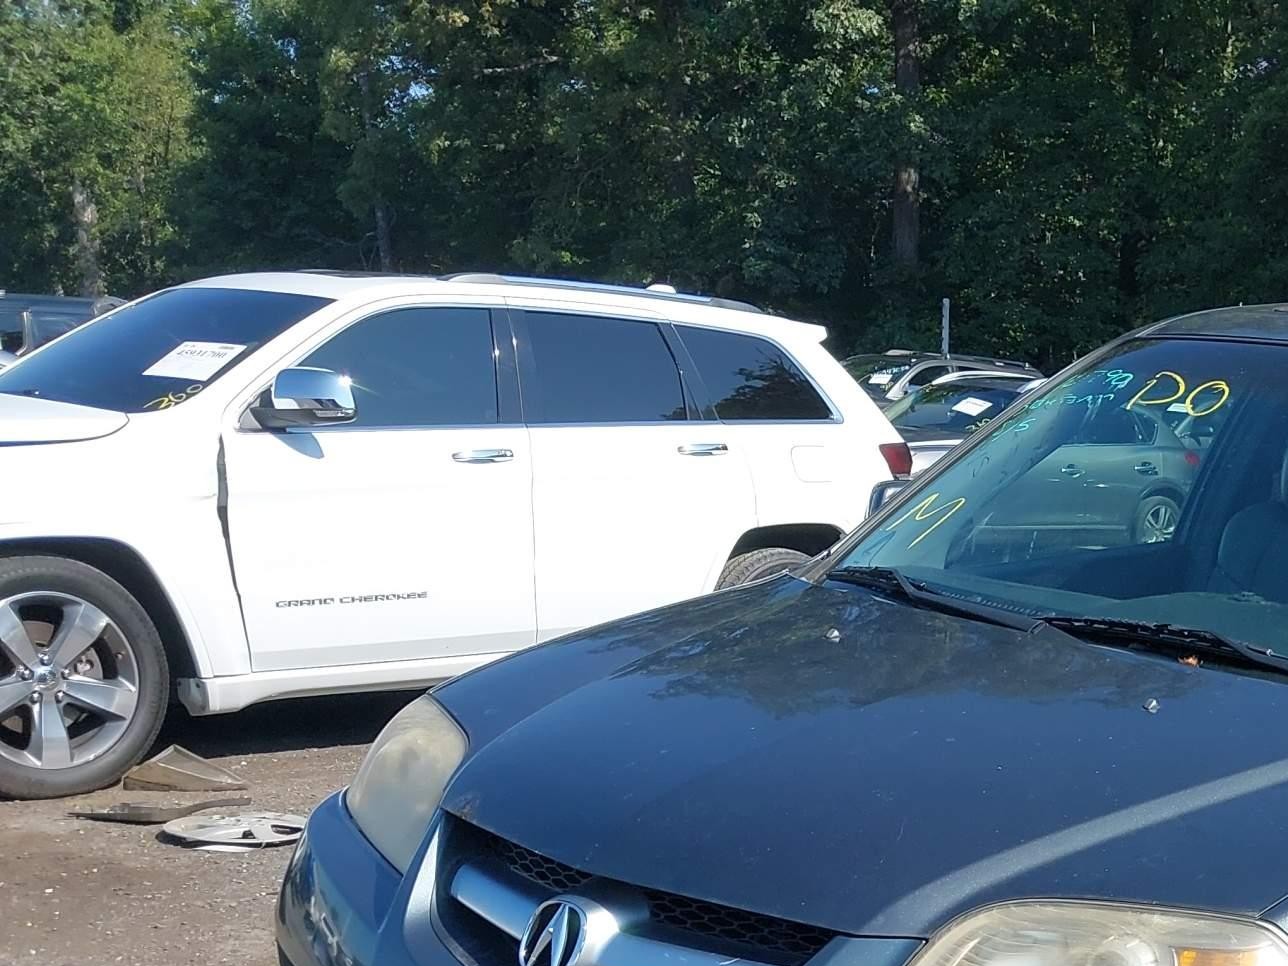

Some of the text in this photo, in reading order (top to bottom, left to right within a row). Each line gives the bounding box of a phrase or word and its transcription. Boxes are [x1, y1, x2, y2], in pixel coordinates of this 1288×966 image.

[885, 492, 966, 551] M
[275, 591, 428, 608] GRAND CHEROKEE
